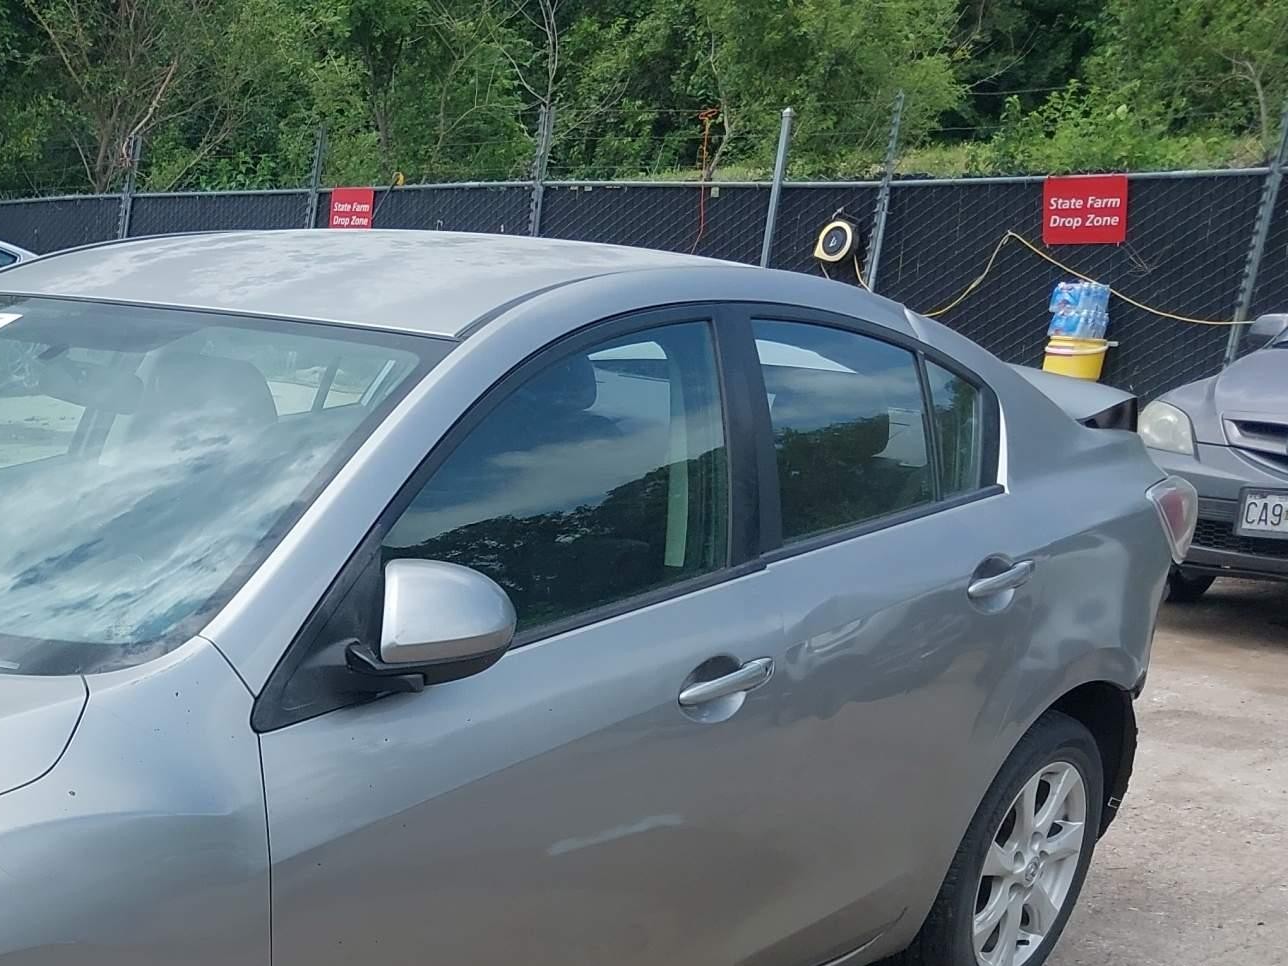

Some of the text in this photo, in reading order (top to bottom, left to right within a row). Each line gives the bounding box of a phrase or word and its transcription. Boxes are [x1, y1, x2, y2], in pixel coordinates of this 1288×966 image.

[333, 202, 370, 212] State Farm
[1049, 196, 1121, 210] State Farm
[333, 215, 369, 228] Drop Zone
[1049, 214, 1119, 230] Drop Zone
[1245, 501, 1284, 526] CA9
